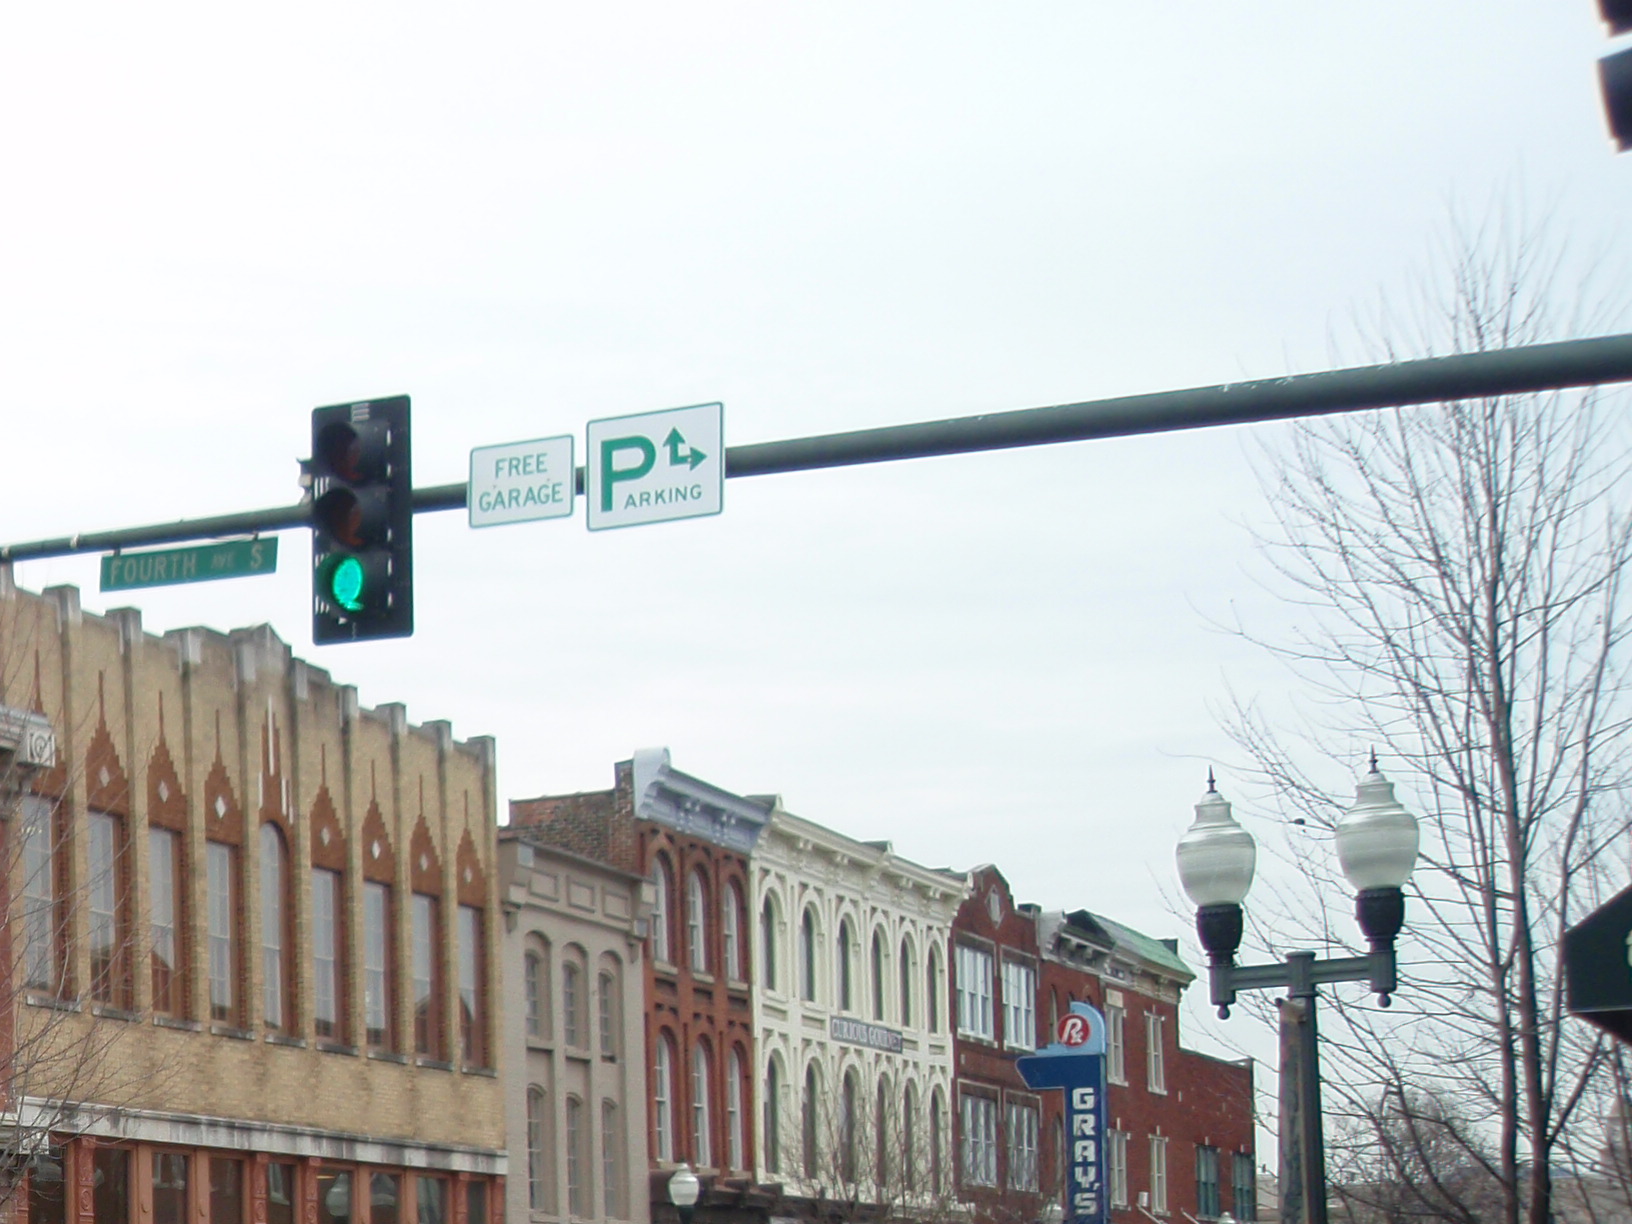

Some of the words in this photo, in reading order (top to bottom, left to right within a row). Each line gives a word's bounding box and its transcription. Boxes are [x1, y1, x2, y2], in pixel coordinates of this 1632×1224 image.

[494, 452, 549, 480] FREE
[478, 482, 564, 512] GARAGE
[110, 552, 198, 586] FOURTH
[250, 543, 264, 570] S
[831, 1018, 868, 1044] CURIOUS
[1072, 1086, 1100, 1215] GRAY'S
